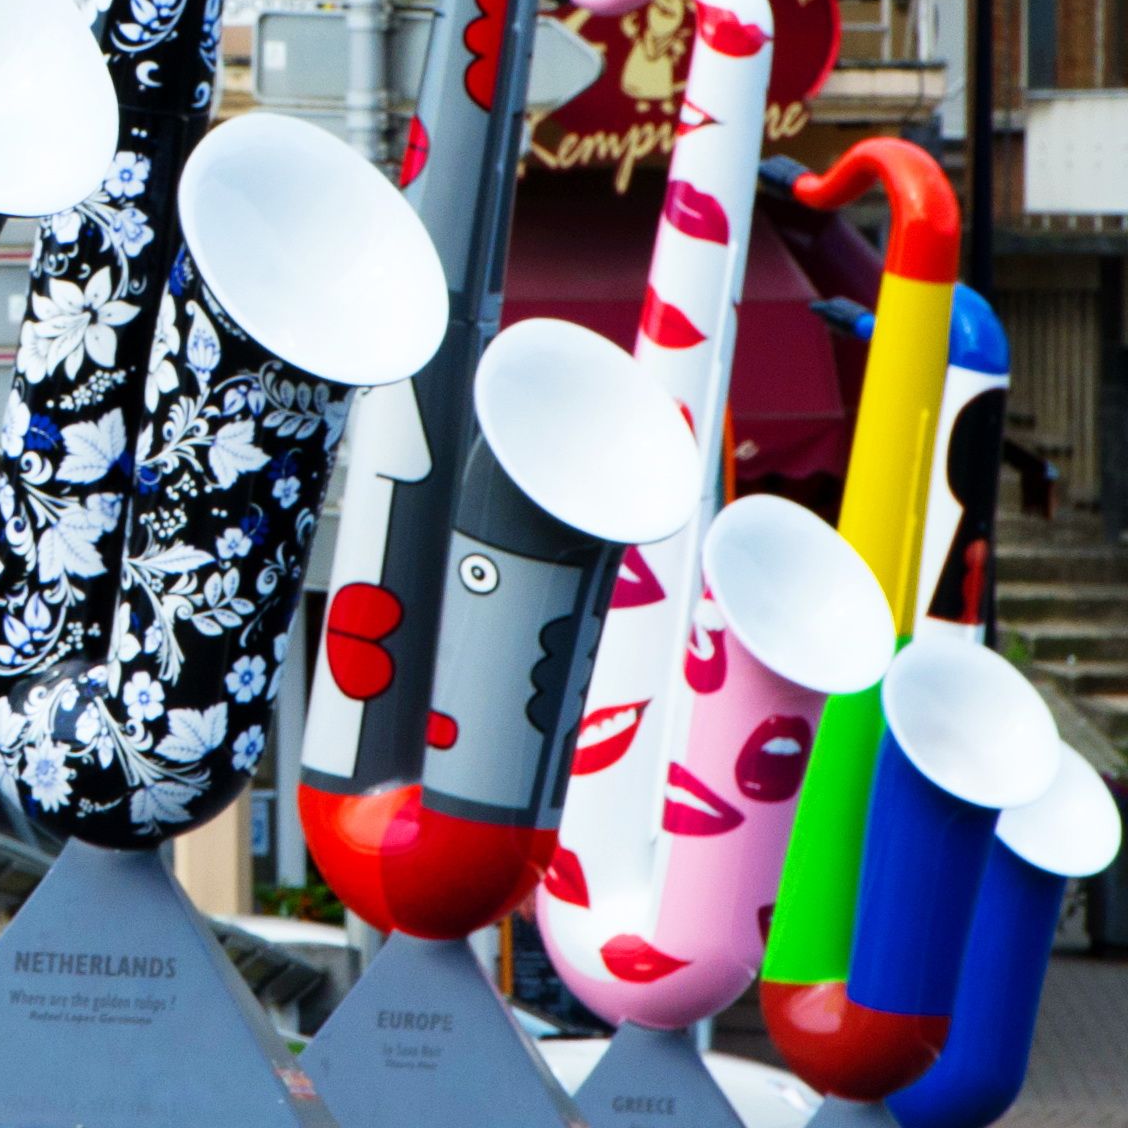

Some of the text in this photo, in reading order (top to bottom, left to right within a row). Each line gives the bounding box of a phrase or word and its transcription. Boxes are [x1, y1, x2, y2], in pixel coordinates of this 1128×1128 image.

[13, 950, 177, 979] NETHERLANDS
[377, 1009, 453, 1032] EUROPE
[612, 1095, 677, 1115] GREECE
